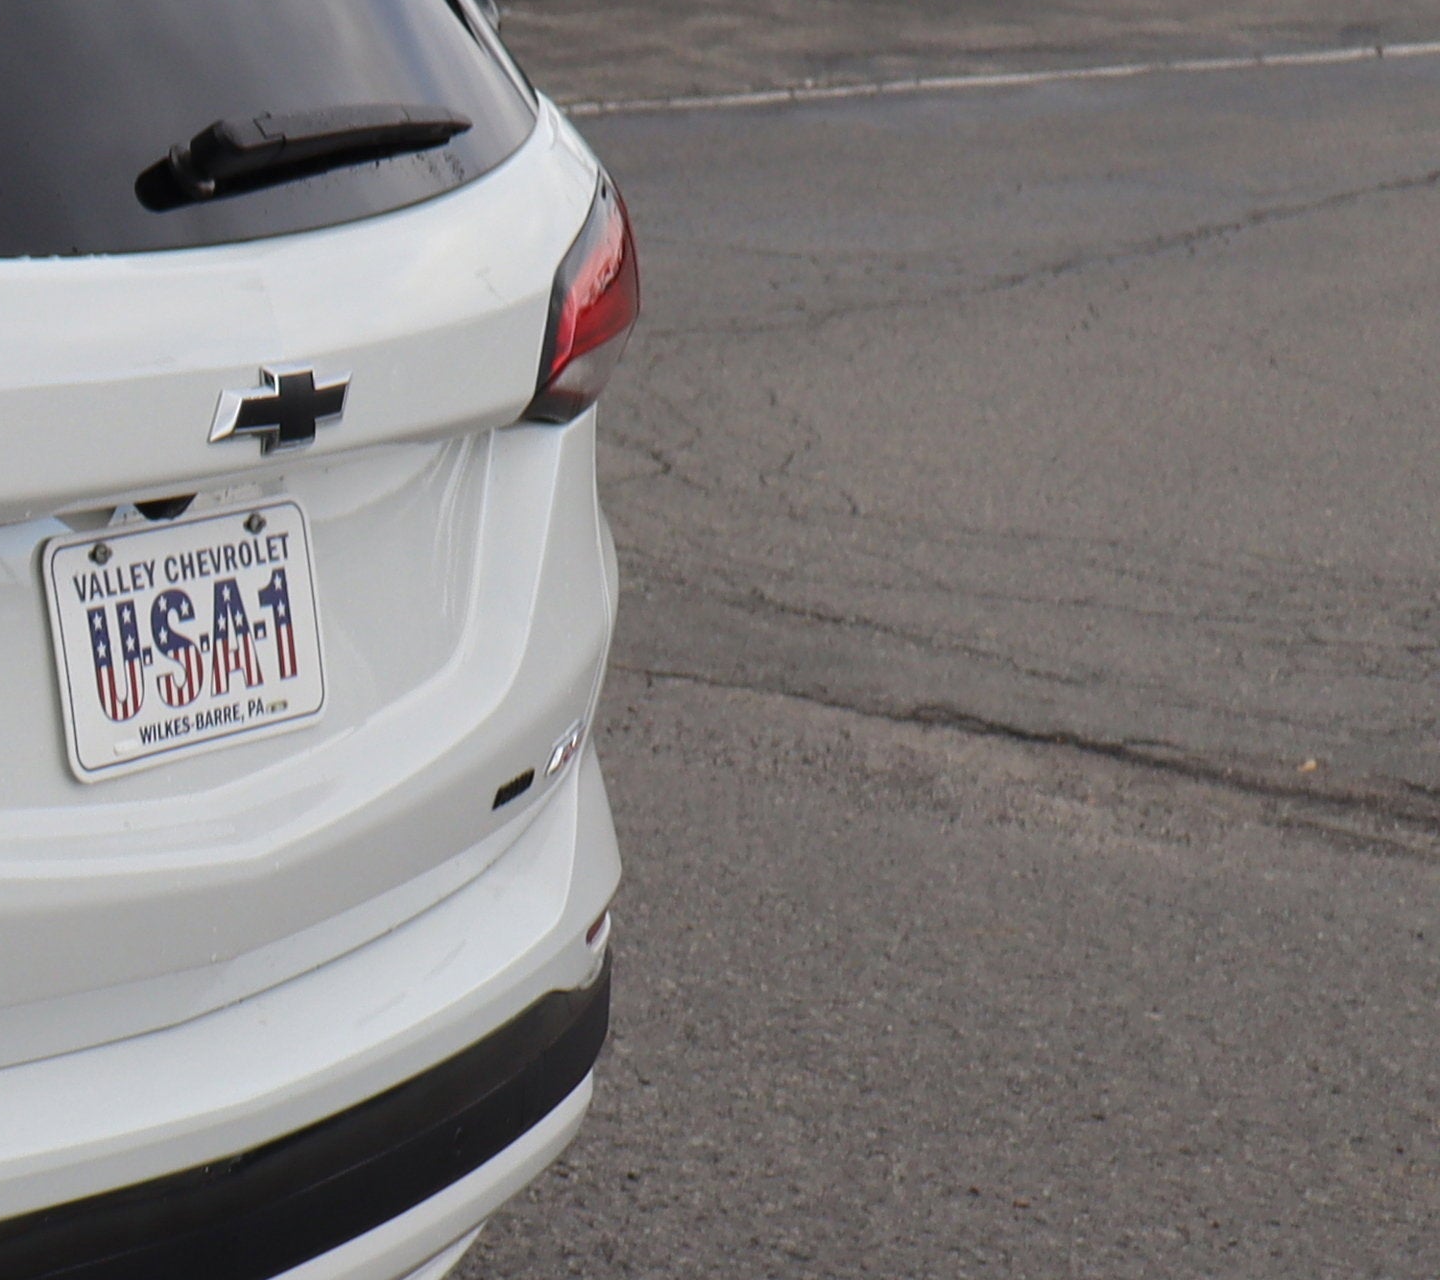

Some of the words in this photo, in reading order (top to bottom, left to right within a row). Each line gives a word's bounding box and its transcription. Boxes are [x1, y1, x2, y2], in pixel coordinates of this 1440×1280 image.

[72, 559, 157, 603] VALLEY
[163, 532, 290, 583] CHEVROLET
[139, 702, 245, 745] WILKES-BARRE,
[248, 697, 265, 719] PA
